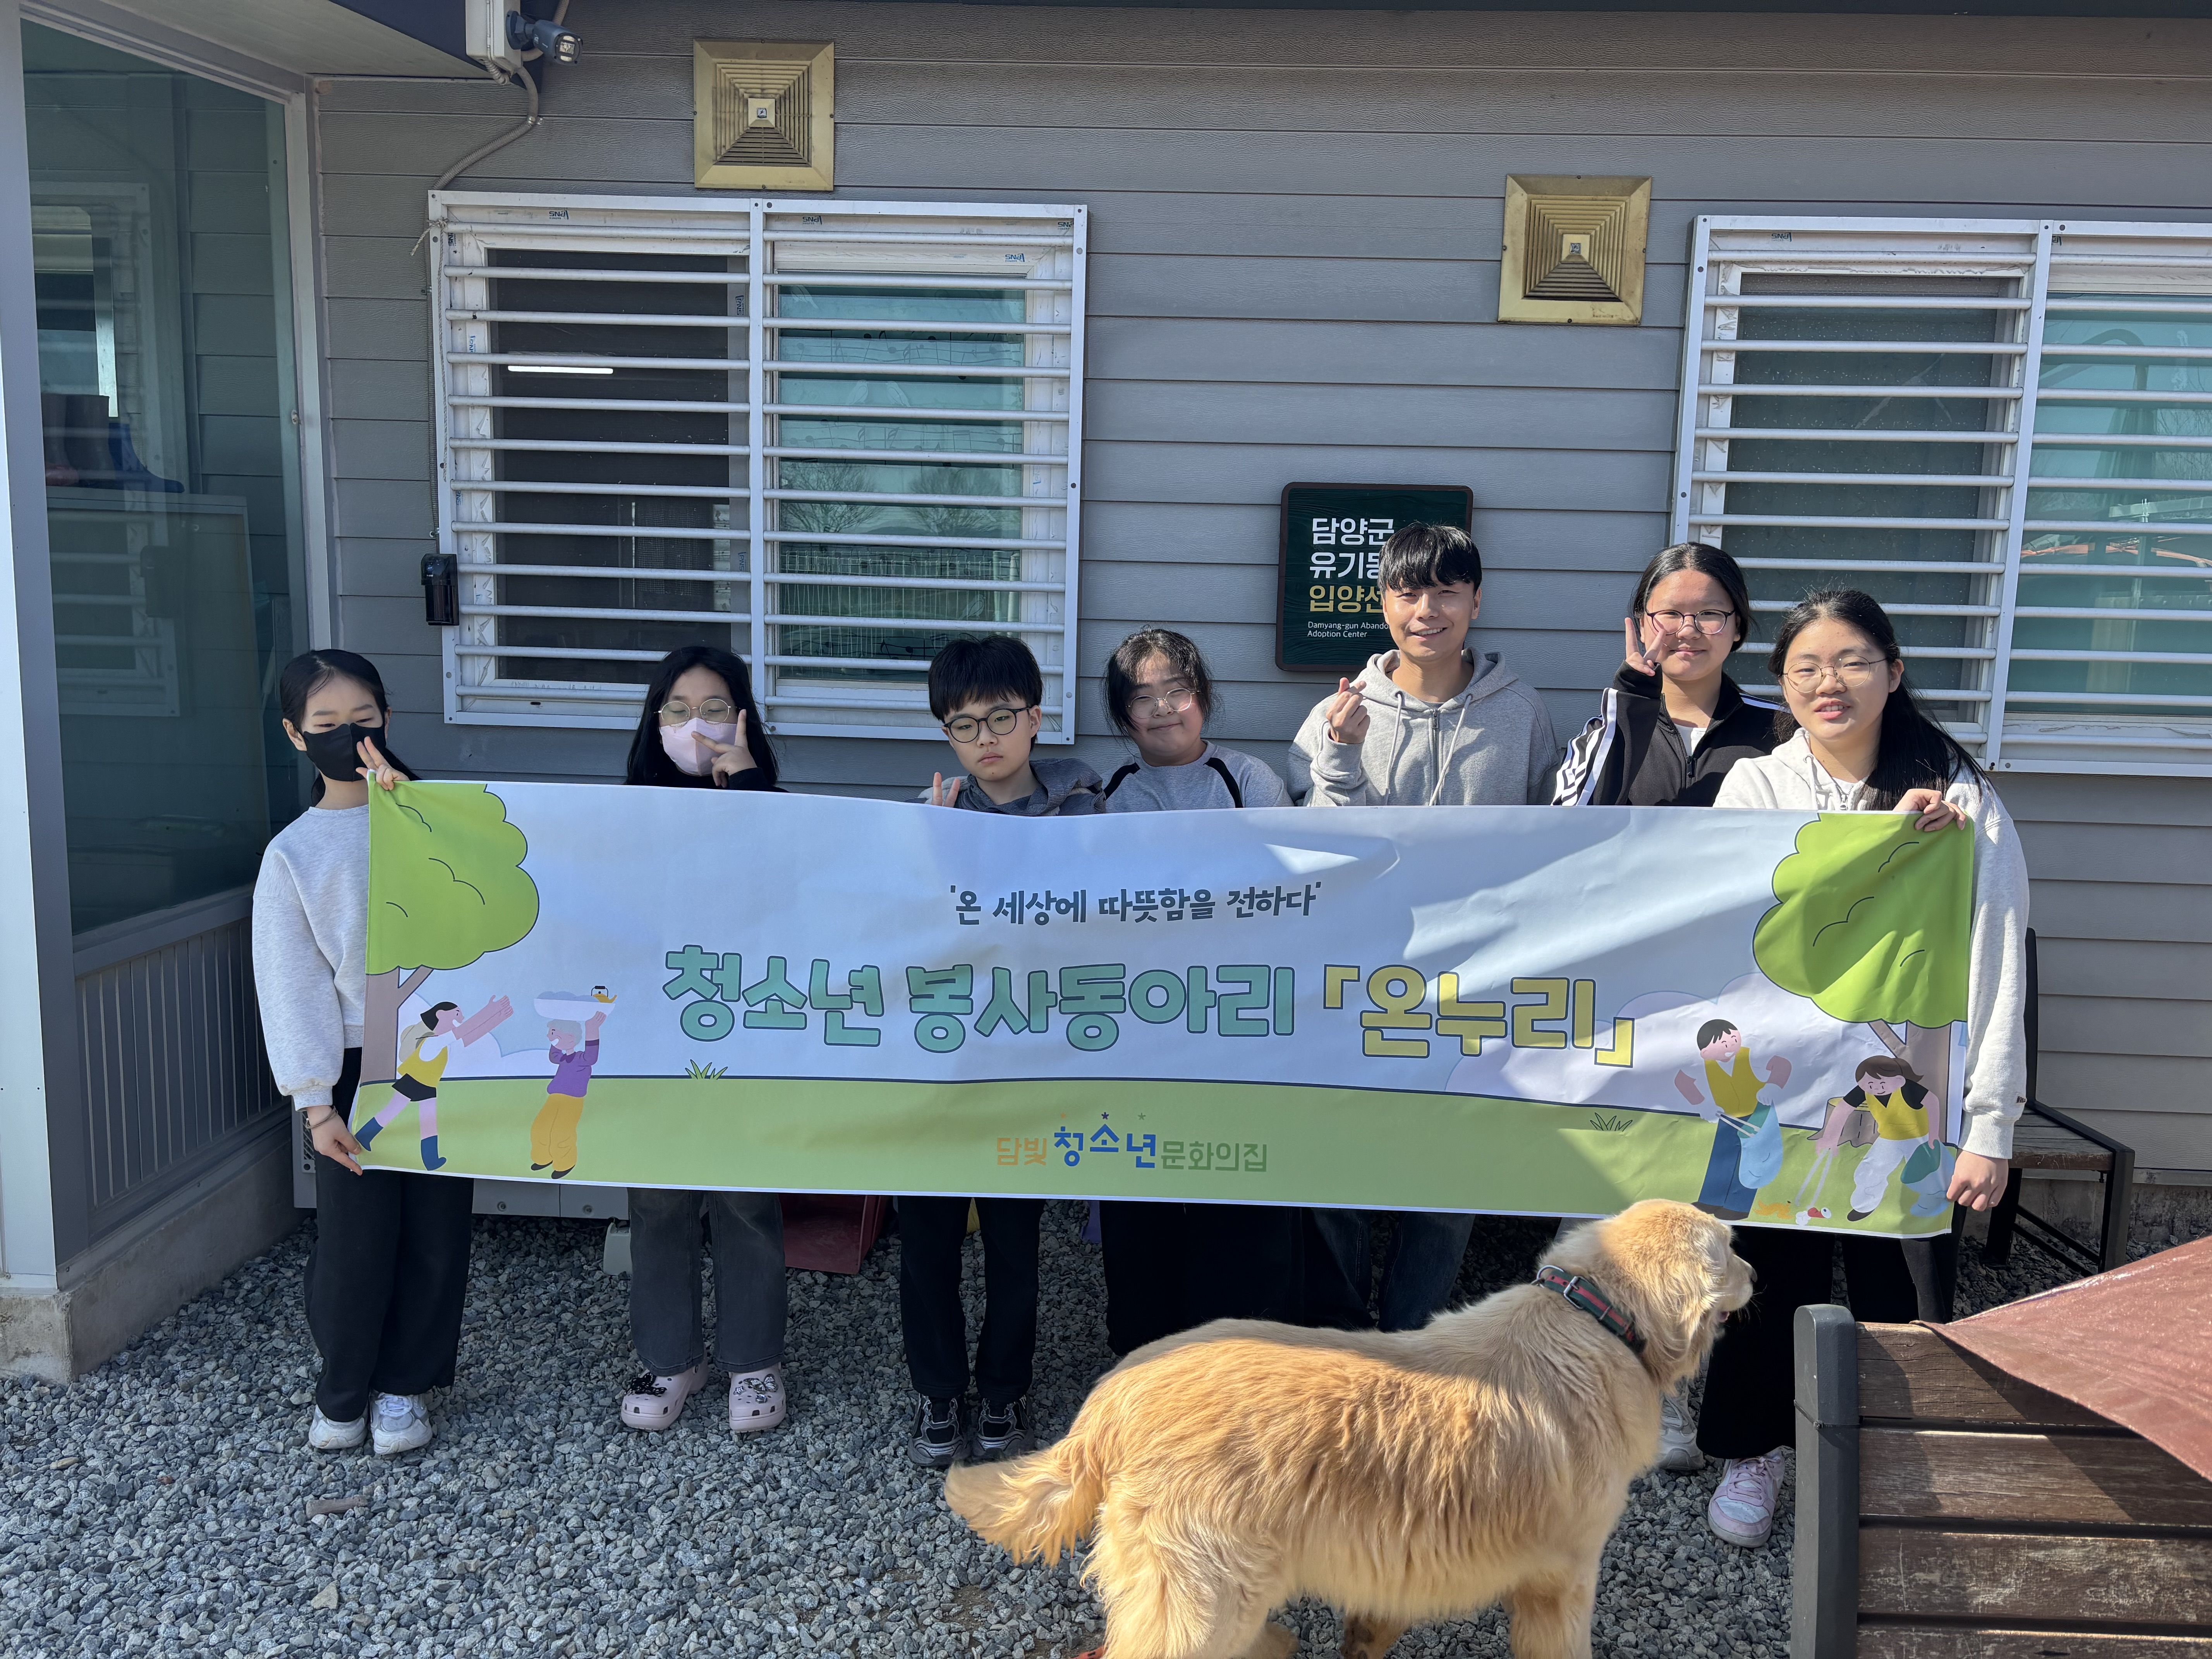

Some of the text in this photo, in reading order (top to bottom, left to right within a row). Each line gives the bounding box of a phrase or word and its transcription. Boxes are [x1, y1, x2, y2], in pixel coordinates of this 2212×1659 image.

[1312, 518, 1394, 546] 담양군
[1307, 630, 1341, 638] Adoption
[1308, 621, 1358, 630] Damyang-gun
[992, 889, 1087, 926] 세상에
[1098, 888, 1216, 923] 따뜻함을
[662, 944, 884, 1047] 청소년
[906, 962, 1295, 1054] 봉사동아리
